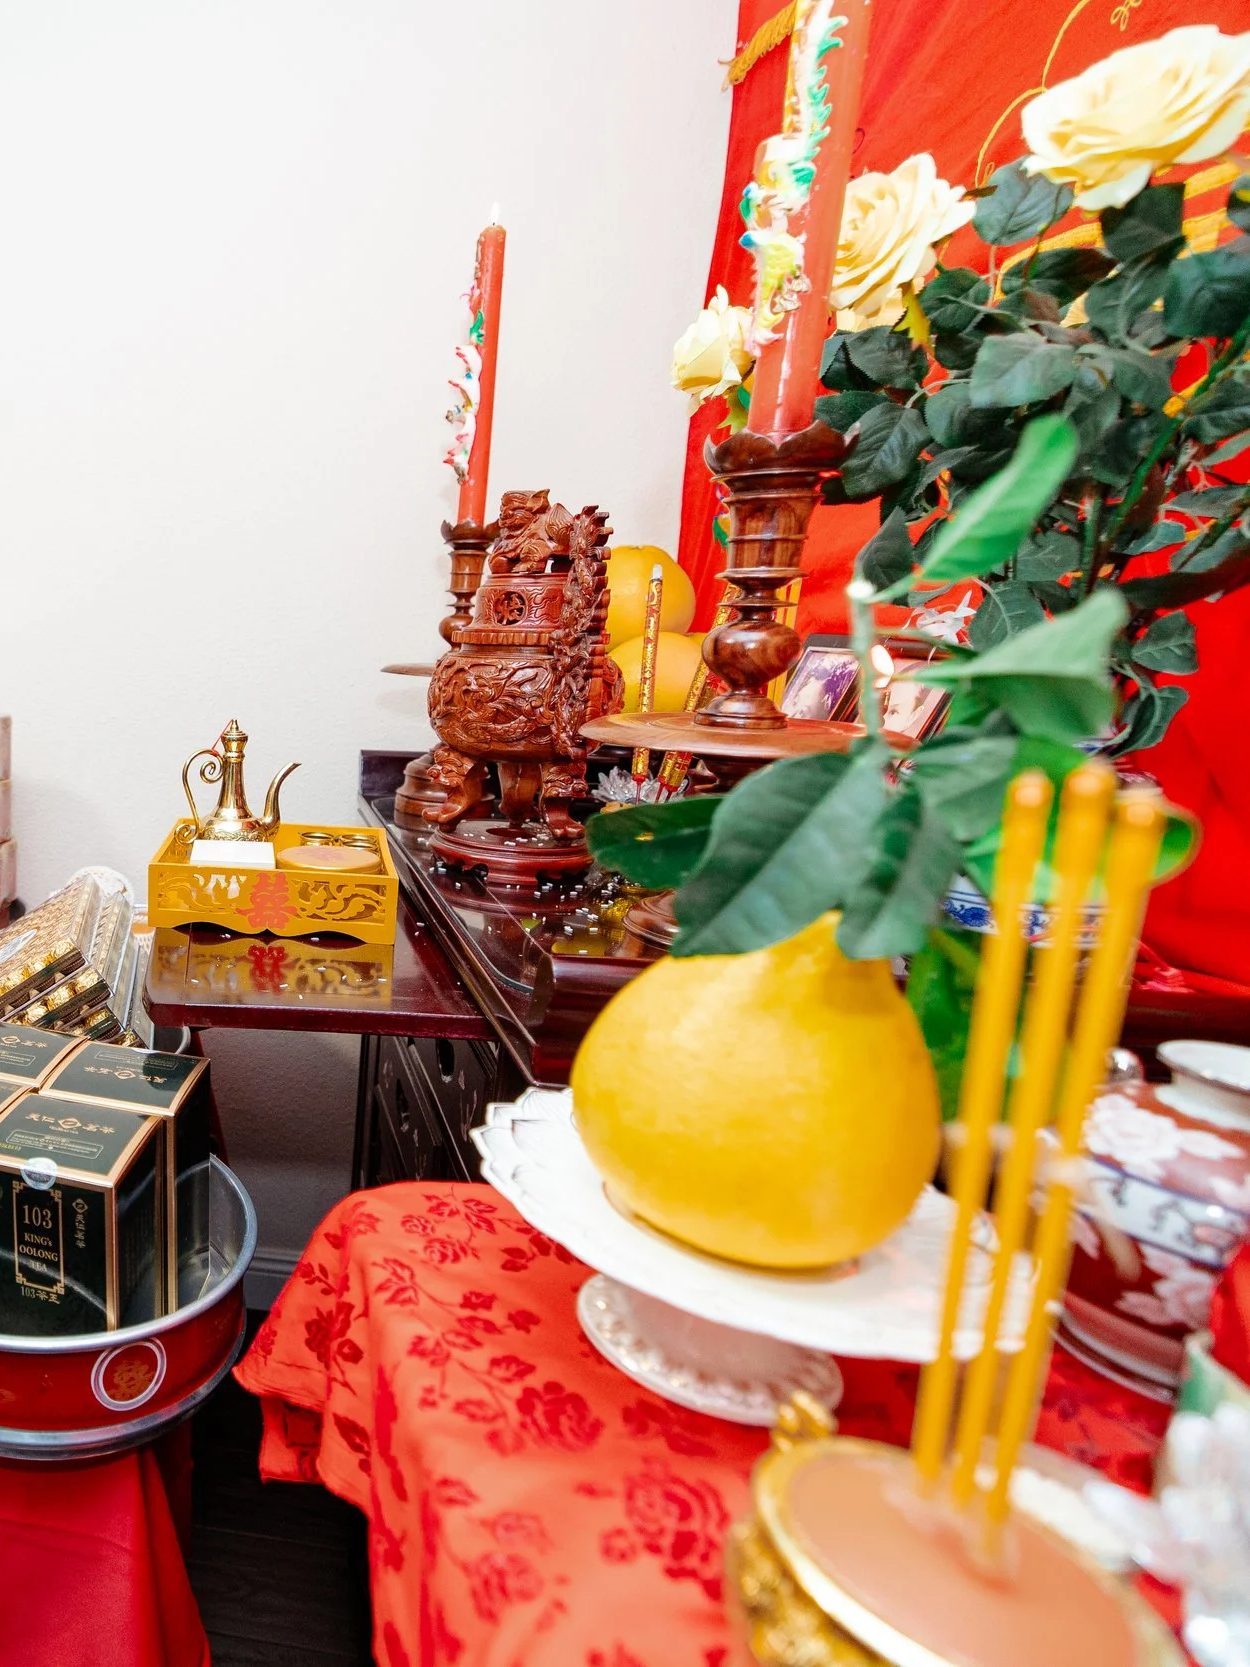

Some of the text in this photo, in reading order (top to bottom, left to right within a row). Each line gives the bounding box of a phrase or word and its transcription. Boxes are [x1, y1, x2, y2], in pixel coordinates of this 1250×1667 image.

[23, 1204, 53, 1229] 103
[24, 1232, 53, 1247] KING's
[19, 1244, 58, 1262] OOLONG
[30, 1260, 48, 1272] TEA
